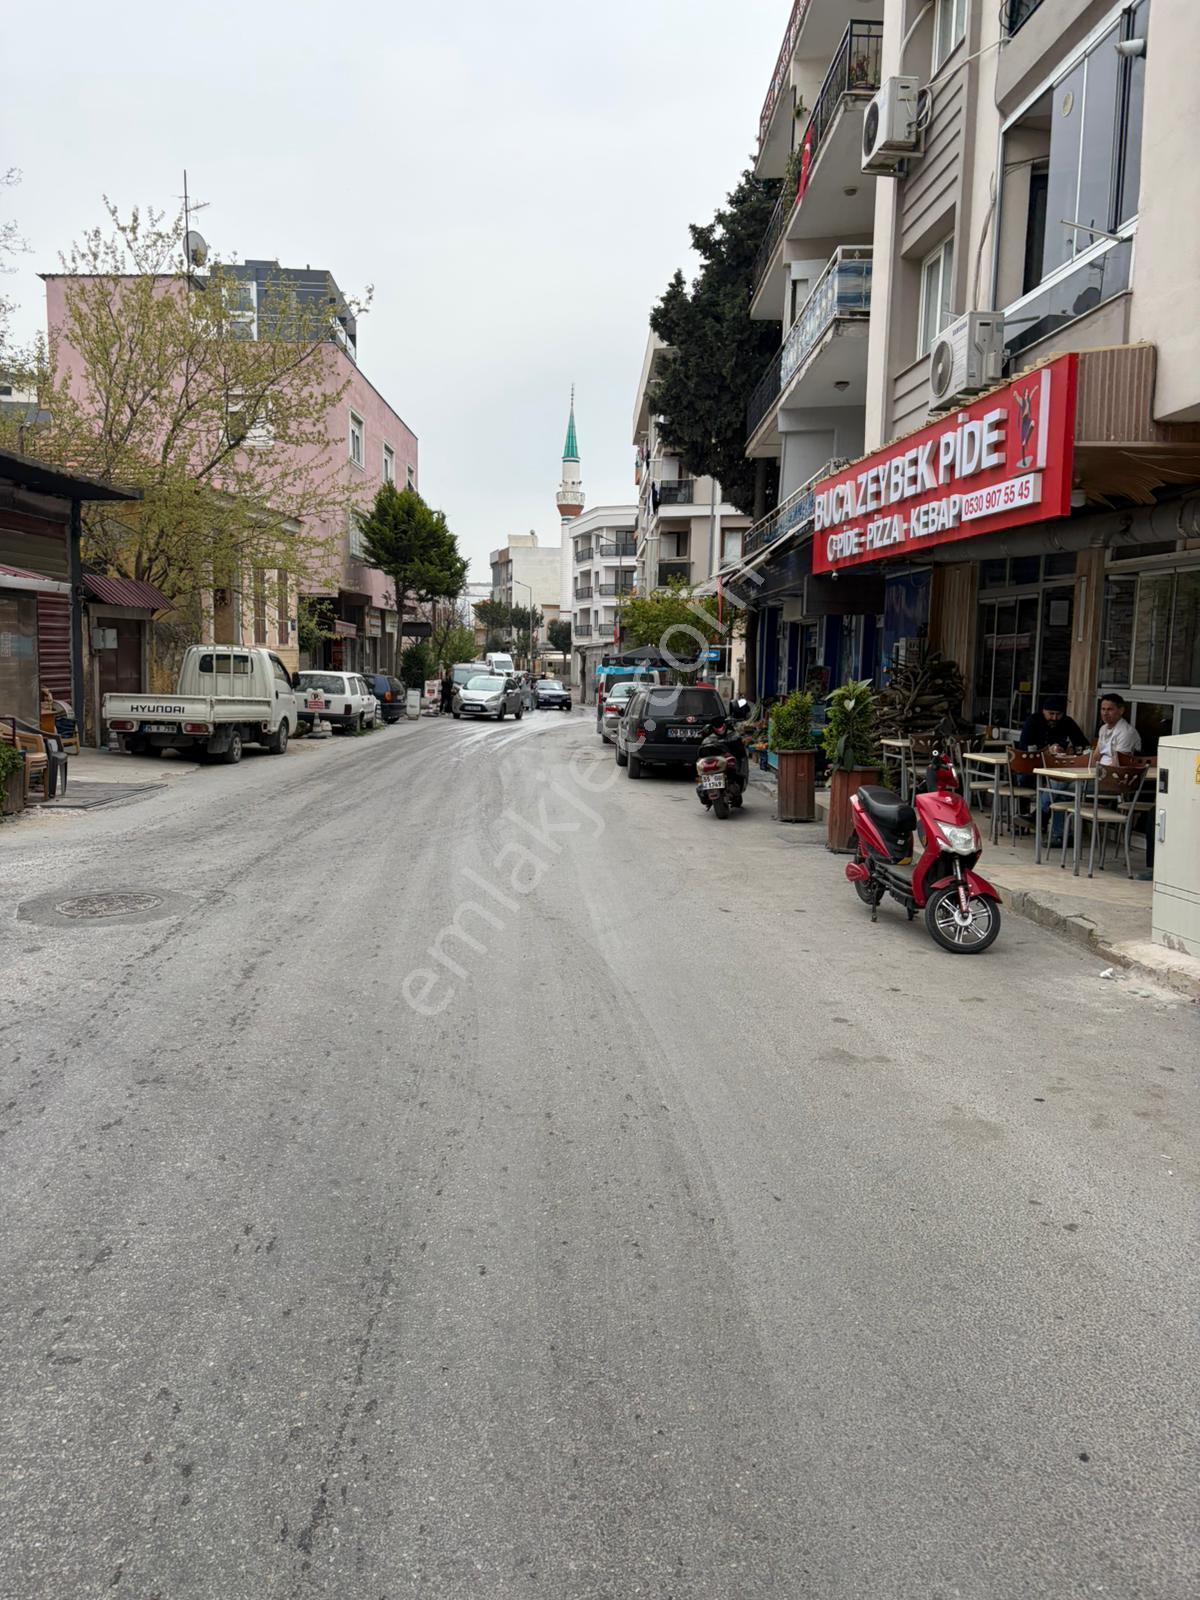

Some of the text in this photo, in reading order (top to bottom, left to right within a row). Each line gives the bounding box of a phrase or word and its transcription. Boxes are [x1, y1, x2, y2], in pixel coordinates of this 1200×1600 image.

[814, 407, 1006, 531] BUCA ZEYBEK PİDE
[964, 480, 1030, 516] 0530 907 55 45
[130, 704, 185, 714] HYUNDAI
